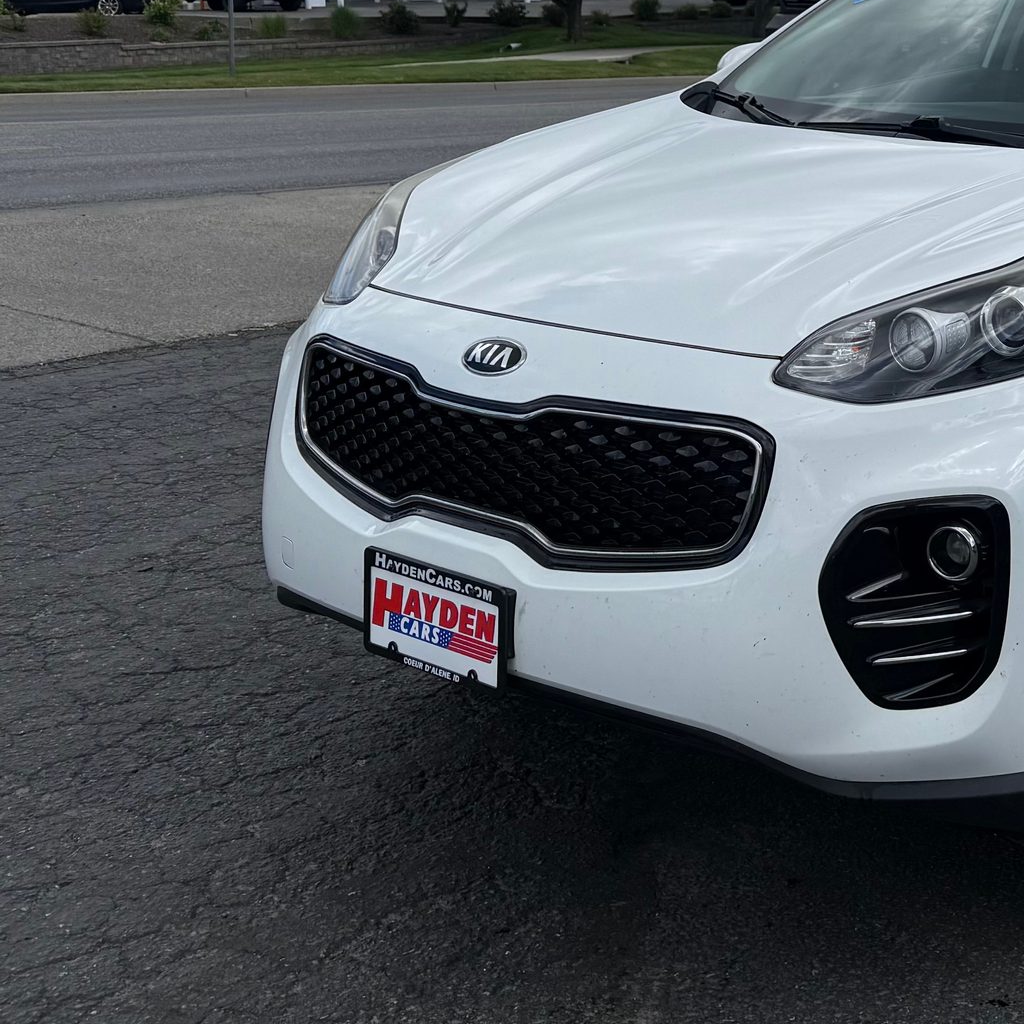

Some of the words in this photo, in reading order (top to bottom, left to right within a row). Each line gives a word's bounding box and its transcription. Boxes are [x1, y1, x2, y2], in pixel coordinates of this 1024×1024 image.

[467, 343, 513, 368] KIA
[372, 577, 496, 643] HAYDEN
[400, 617, 440, 644] CARS
